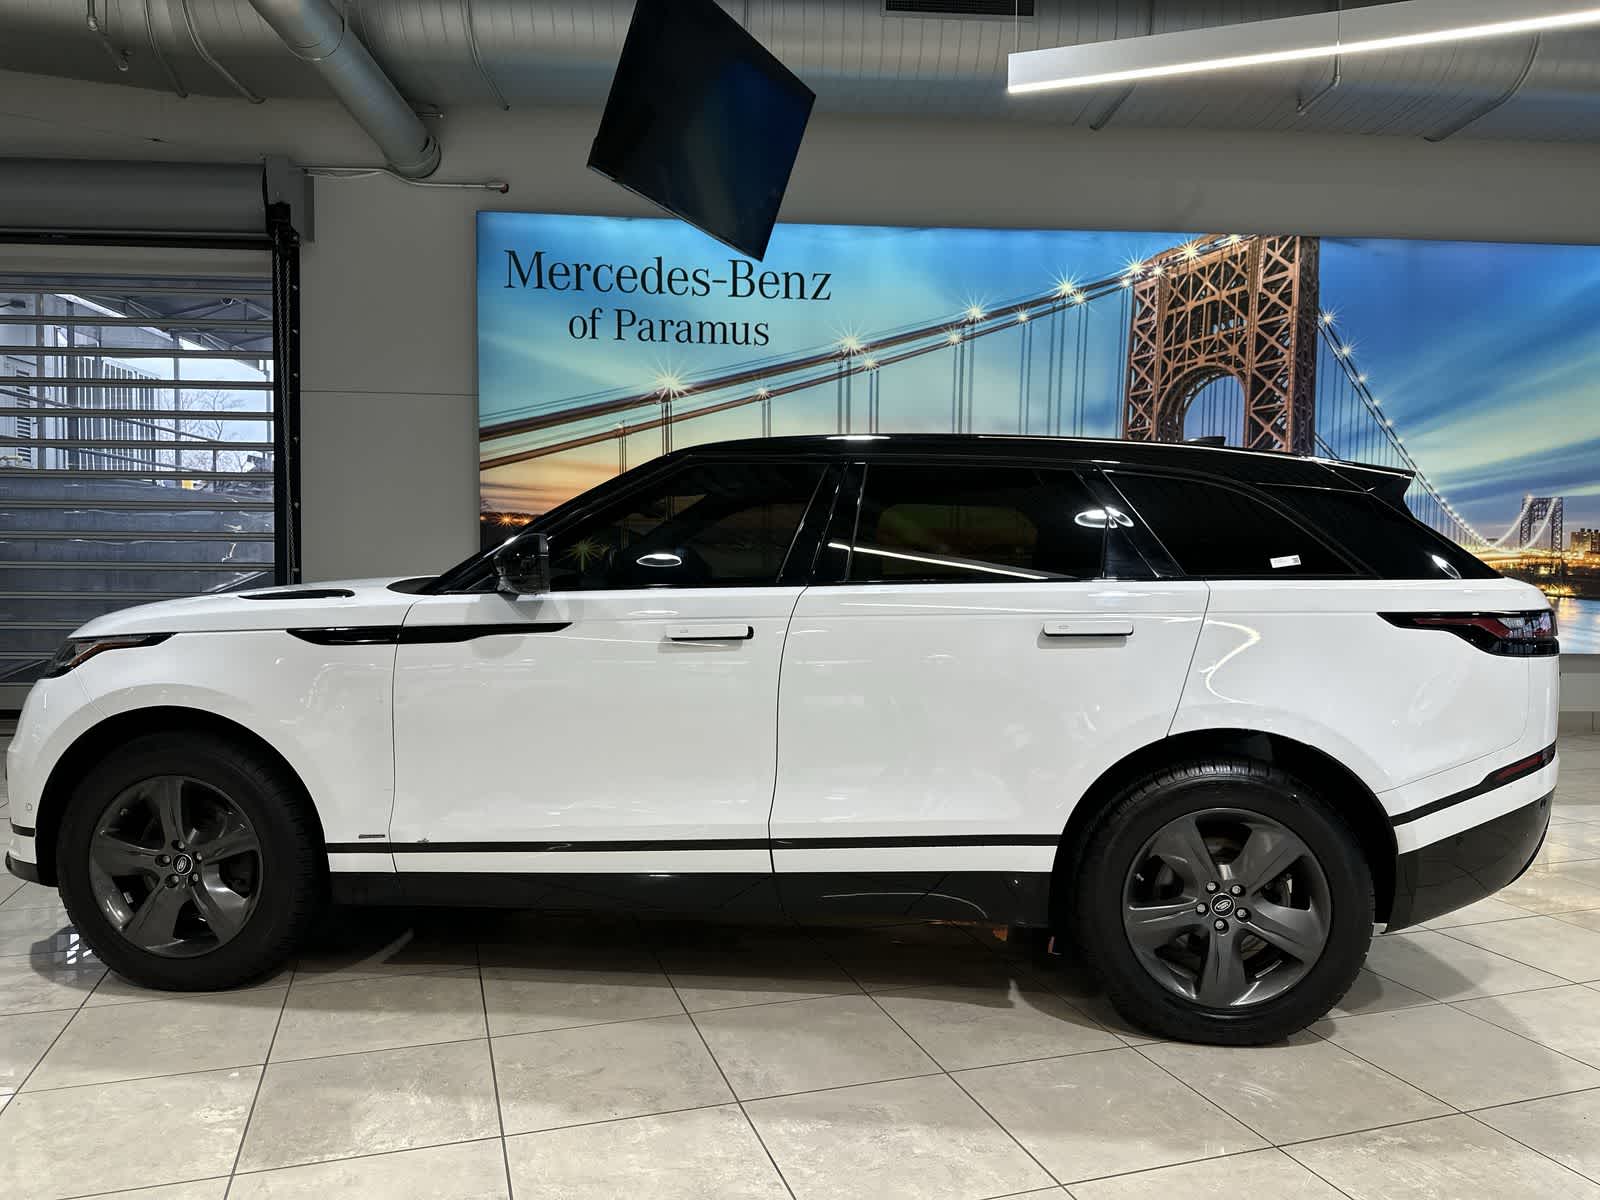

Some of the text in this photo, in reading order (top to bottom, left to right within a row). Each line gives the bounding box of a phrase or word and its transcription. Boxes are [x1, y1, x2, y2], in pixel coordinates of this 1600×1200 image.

[504, 249, 832, 301] Mercedes-Benz
[568, 307, 770, 347] of Paramus
